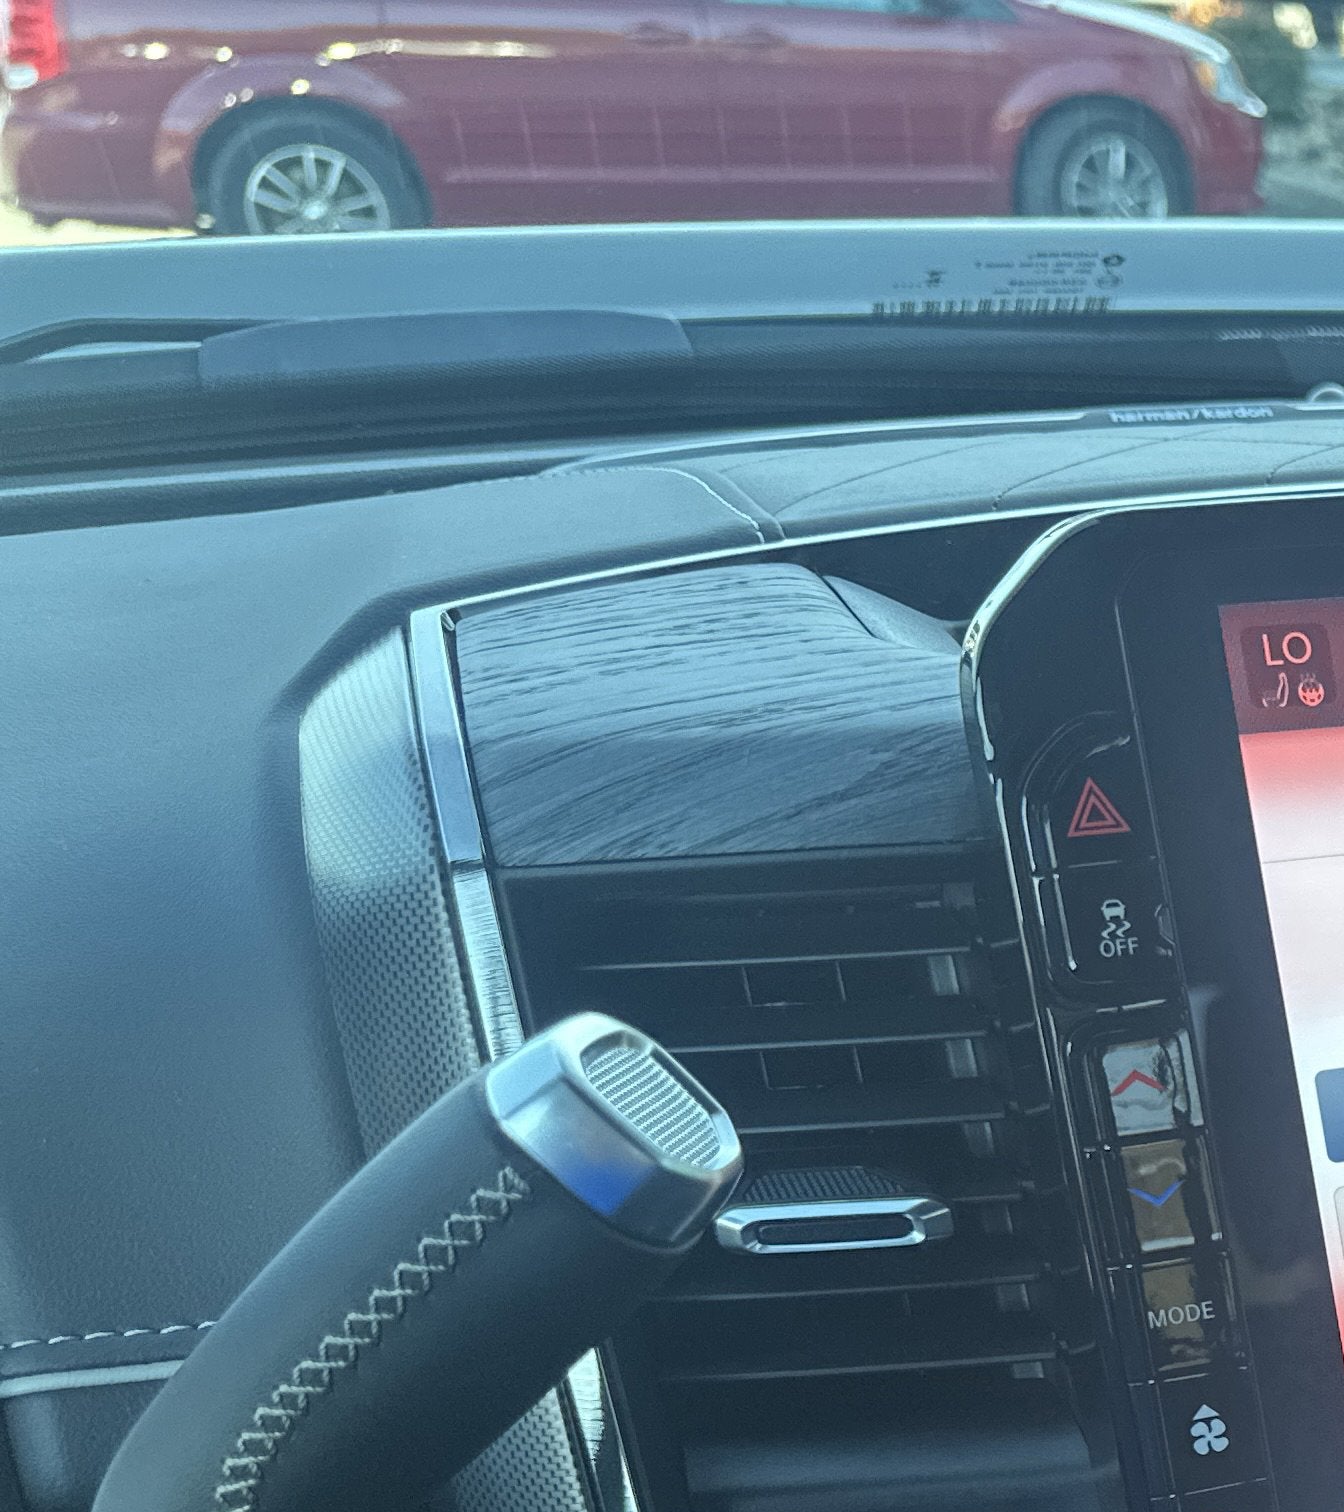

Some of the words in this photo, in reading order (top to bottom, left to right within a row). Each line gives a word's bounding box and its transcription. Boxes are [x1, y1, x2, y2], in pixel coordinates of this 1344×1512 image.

[1108, 406, 1274, 423] harman/kardon
[1262, 631, 1312, 666] LO
[1100, 937, 1139, 958] OFF
[1148, 1301, 1215, 1330] MODE
